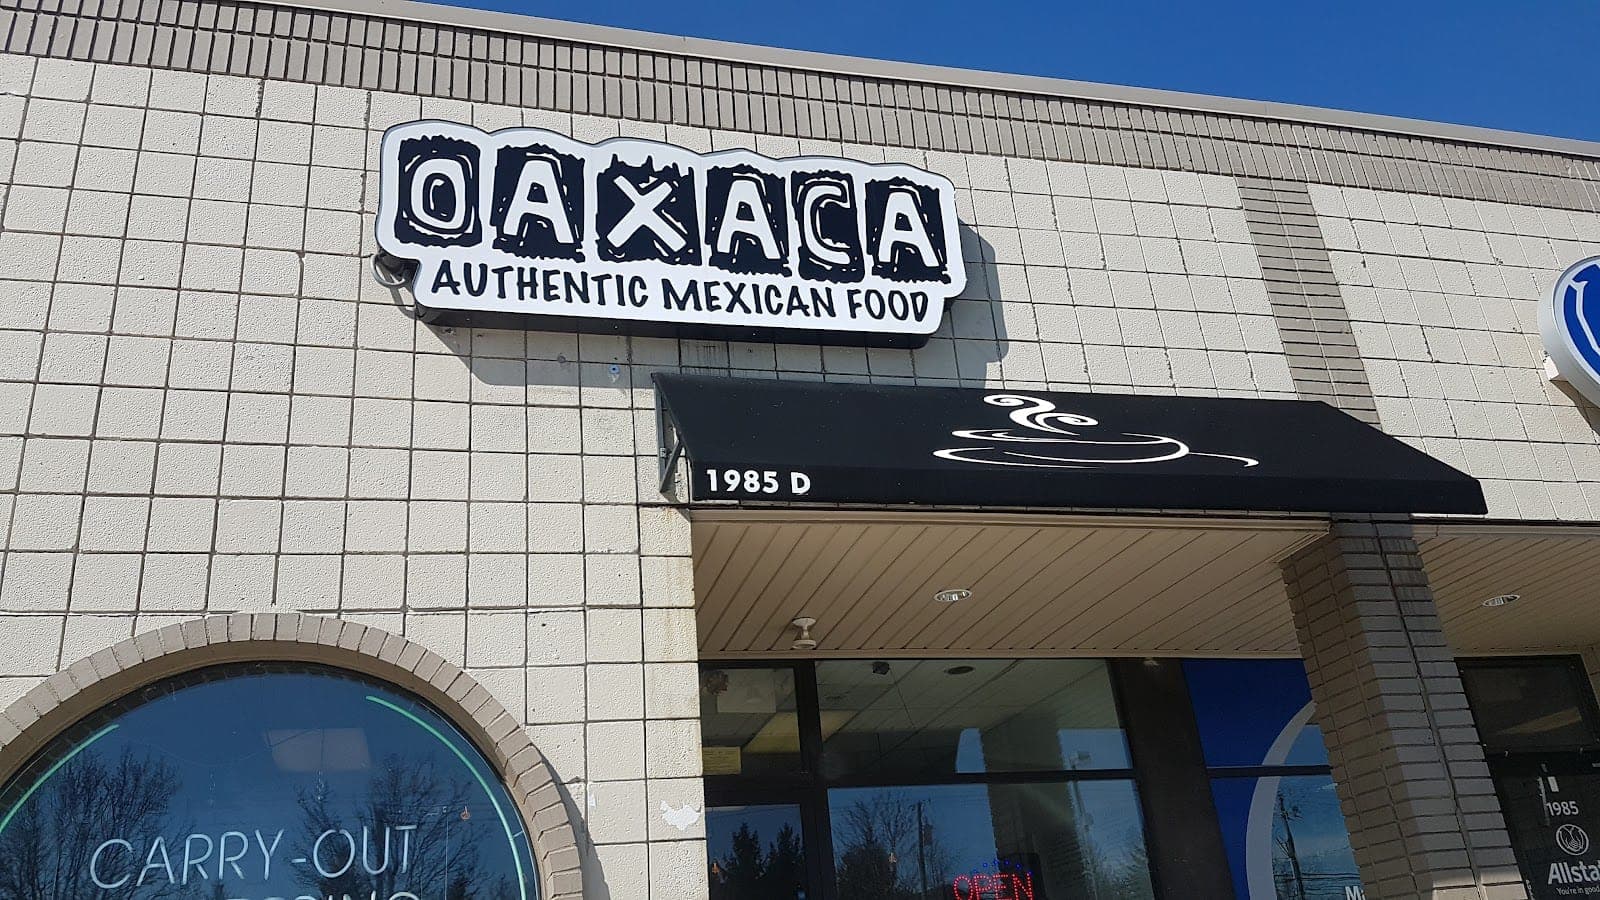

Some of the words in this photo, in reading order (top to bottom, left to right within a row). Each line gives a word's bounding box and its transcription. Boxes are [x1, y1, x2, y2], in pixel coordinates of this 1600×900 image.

[399, 143, 946, 278] OAXACA
[431, 259, 649, 308] AUTHENTIC
[661, 278, 837, 318] MEXICAN
[847, 289, 929, 322] FOOD
[706, 469, 779, 494] 1985
[790, 472, 811, 495] D
[1546, 801, 1579, 816] 1985
[953, 873, 1034, 900] OPEN
